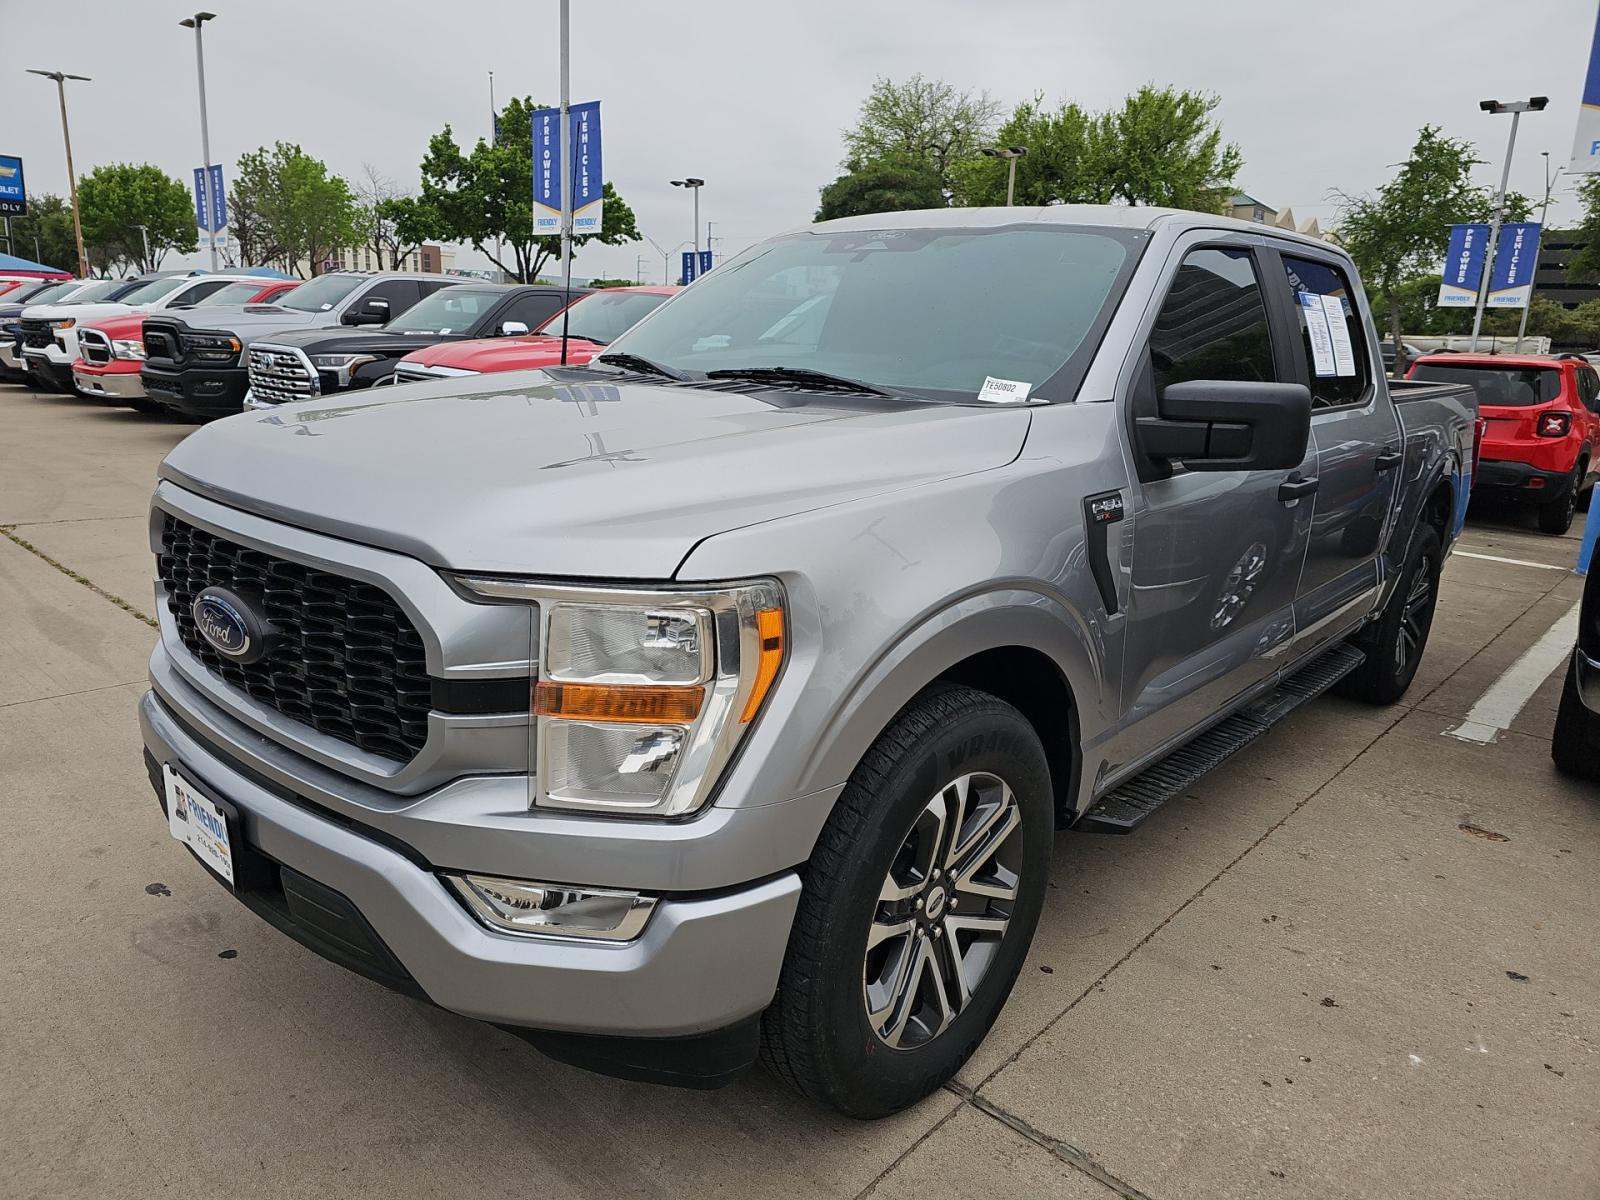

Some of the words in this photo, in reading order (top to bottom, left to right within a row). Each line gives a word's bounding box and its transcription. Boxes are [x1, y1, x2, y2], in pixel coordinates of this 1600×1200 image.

[543, 115, 551, 145] PRE
[581, 111, 590, 197] VEHICLES
[543, 150, 552, 198] OWNED
[1464, 228, 1475, 249] PRE
[1507, 228, 1526, 284] VEHICLES
[1457, 250, 1471, 284] OWNED
[985, 380, 1017, 393] TE50802
[201, 607, 231, 644] Ford
